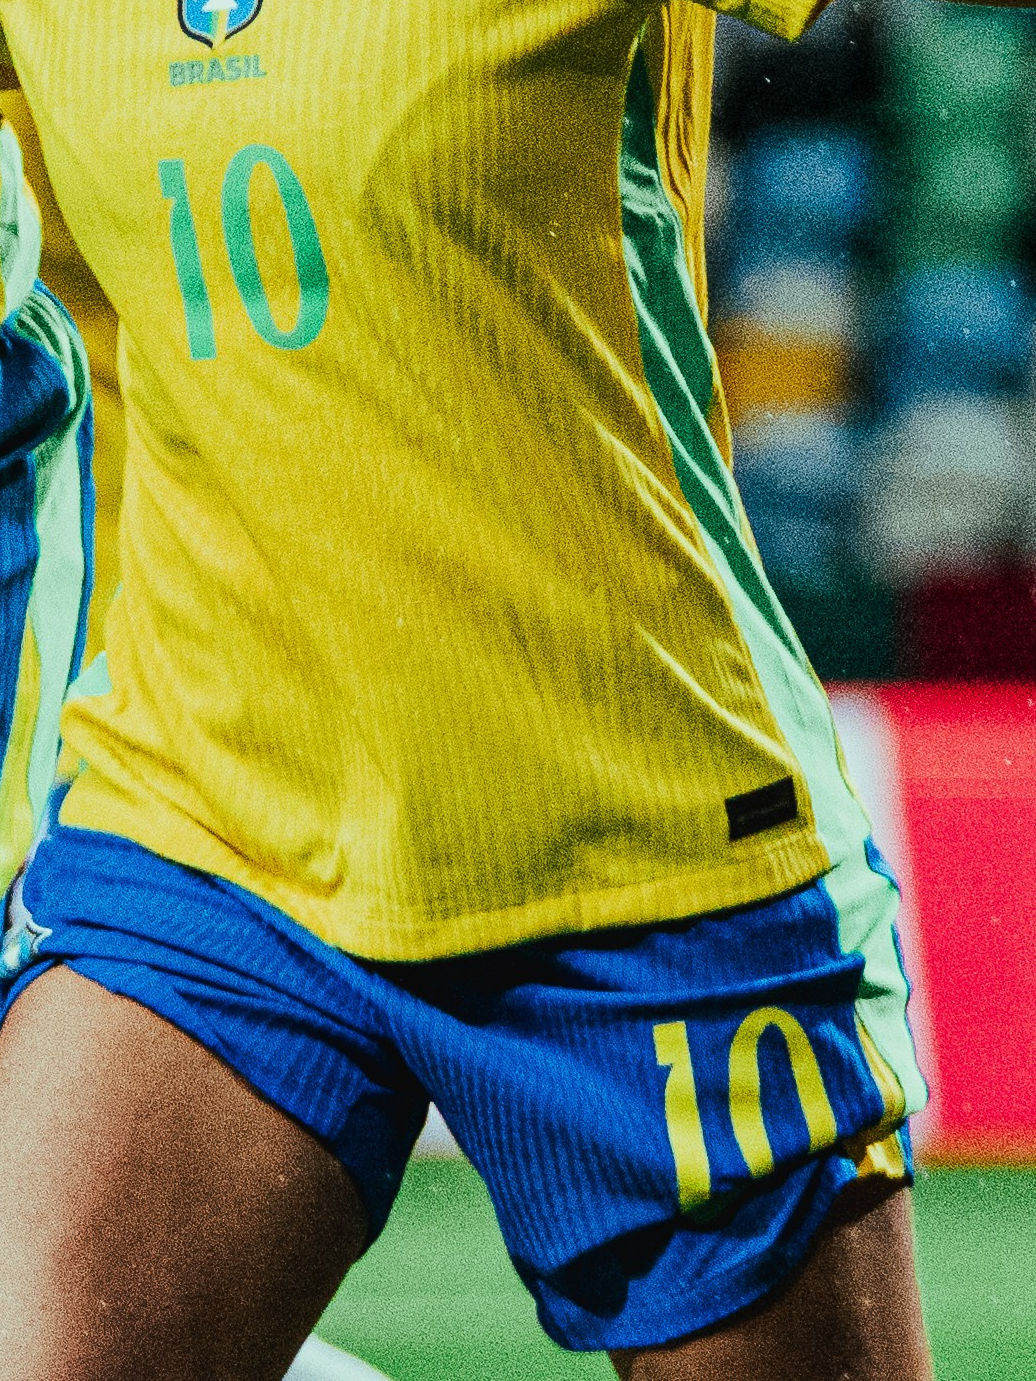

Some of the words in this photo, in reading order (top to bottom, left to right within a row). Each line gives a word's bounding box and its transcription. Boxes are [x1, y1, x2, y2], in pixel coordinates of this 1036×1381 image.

[168, 54, 268, 88] BRASIL
[158, 144, 330, 361] 10
[653, 1007, 837, 1215] 10
